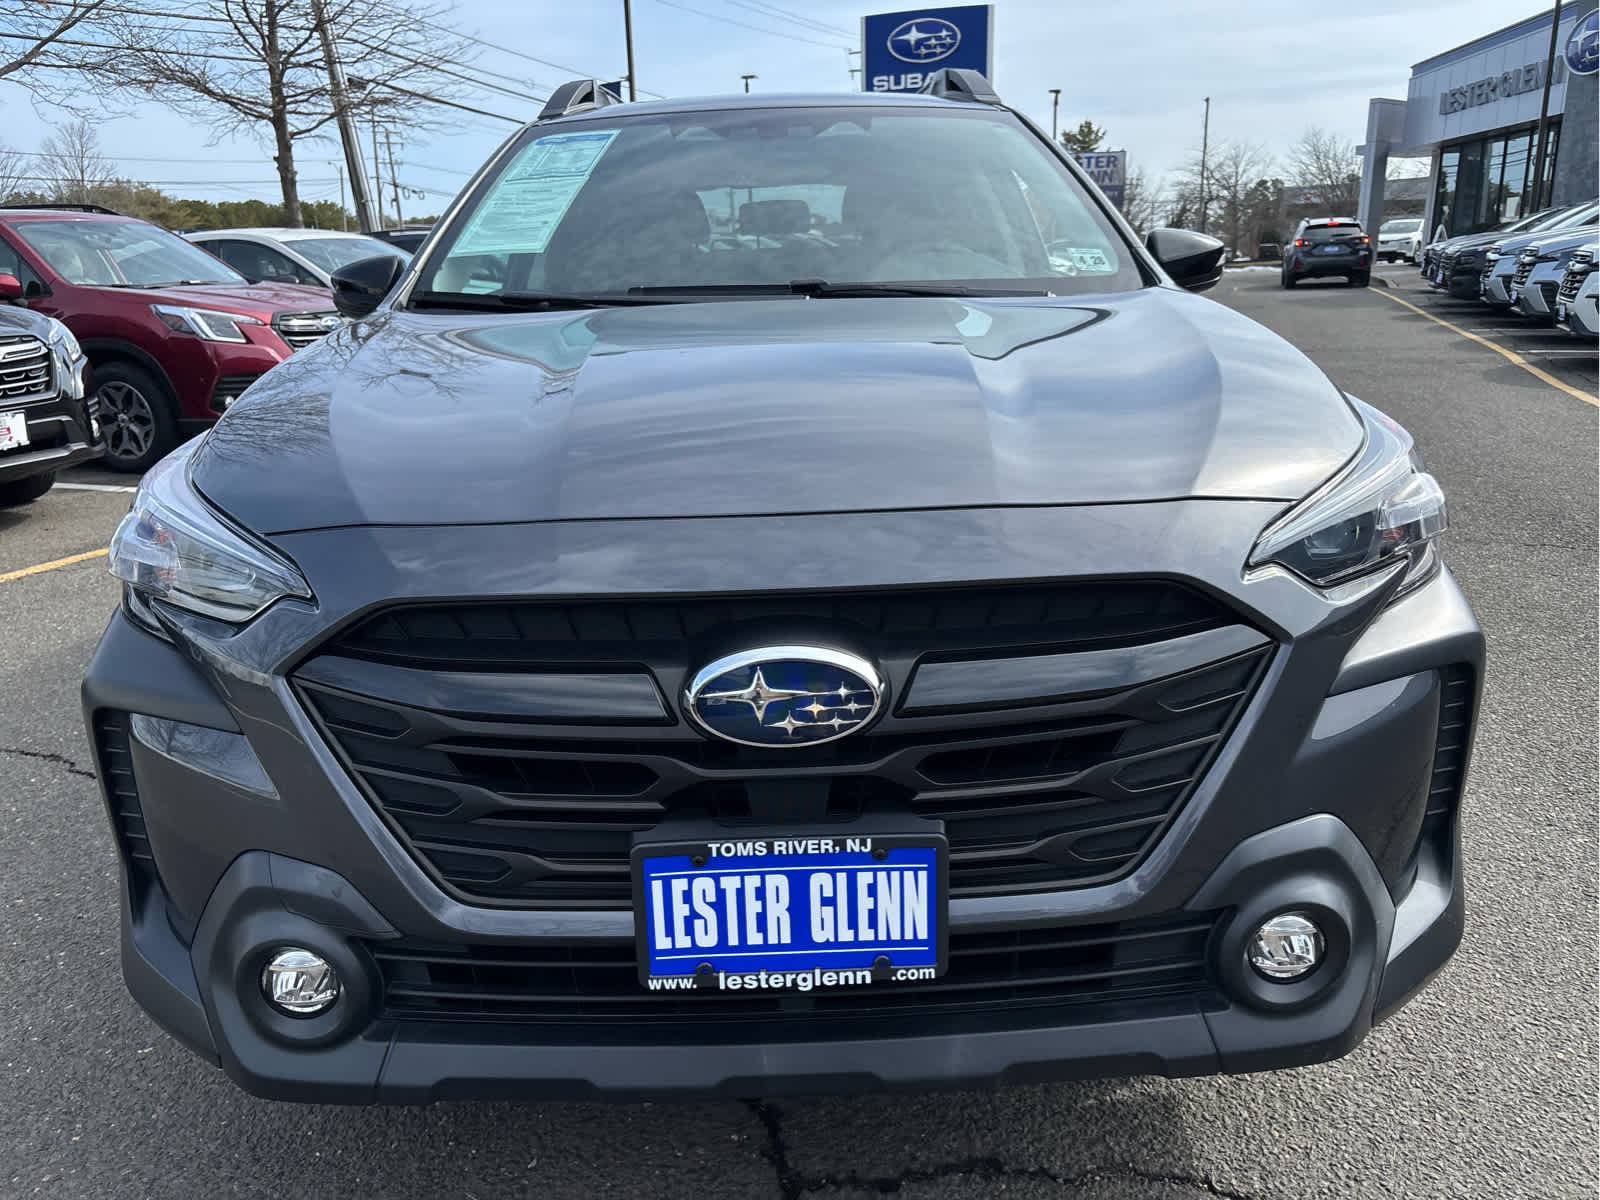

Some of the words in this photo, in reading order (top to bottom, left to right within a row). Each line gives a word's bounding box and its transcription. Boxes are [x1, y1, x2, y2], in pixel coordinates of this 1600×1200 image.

[1440, 76, 1500, 115] LESTER
[1083, 155, 1118, 169] TER
[707, 840, 768, 858] TOMS
[773, 839, 840, 855] RIVER,
[846, 838, 872, 853] NJ
[651, 874, 792, 950] LESTER
[809, 870, 929, 943] GLENN
[647, 976, 698, 991] www.
[718, 967, 872, 992] lesterglenn
[890, 967, 936, 981] .com
